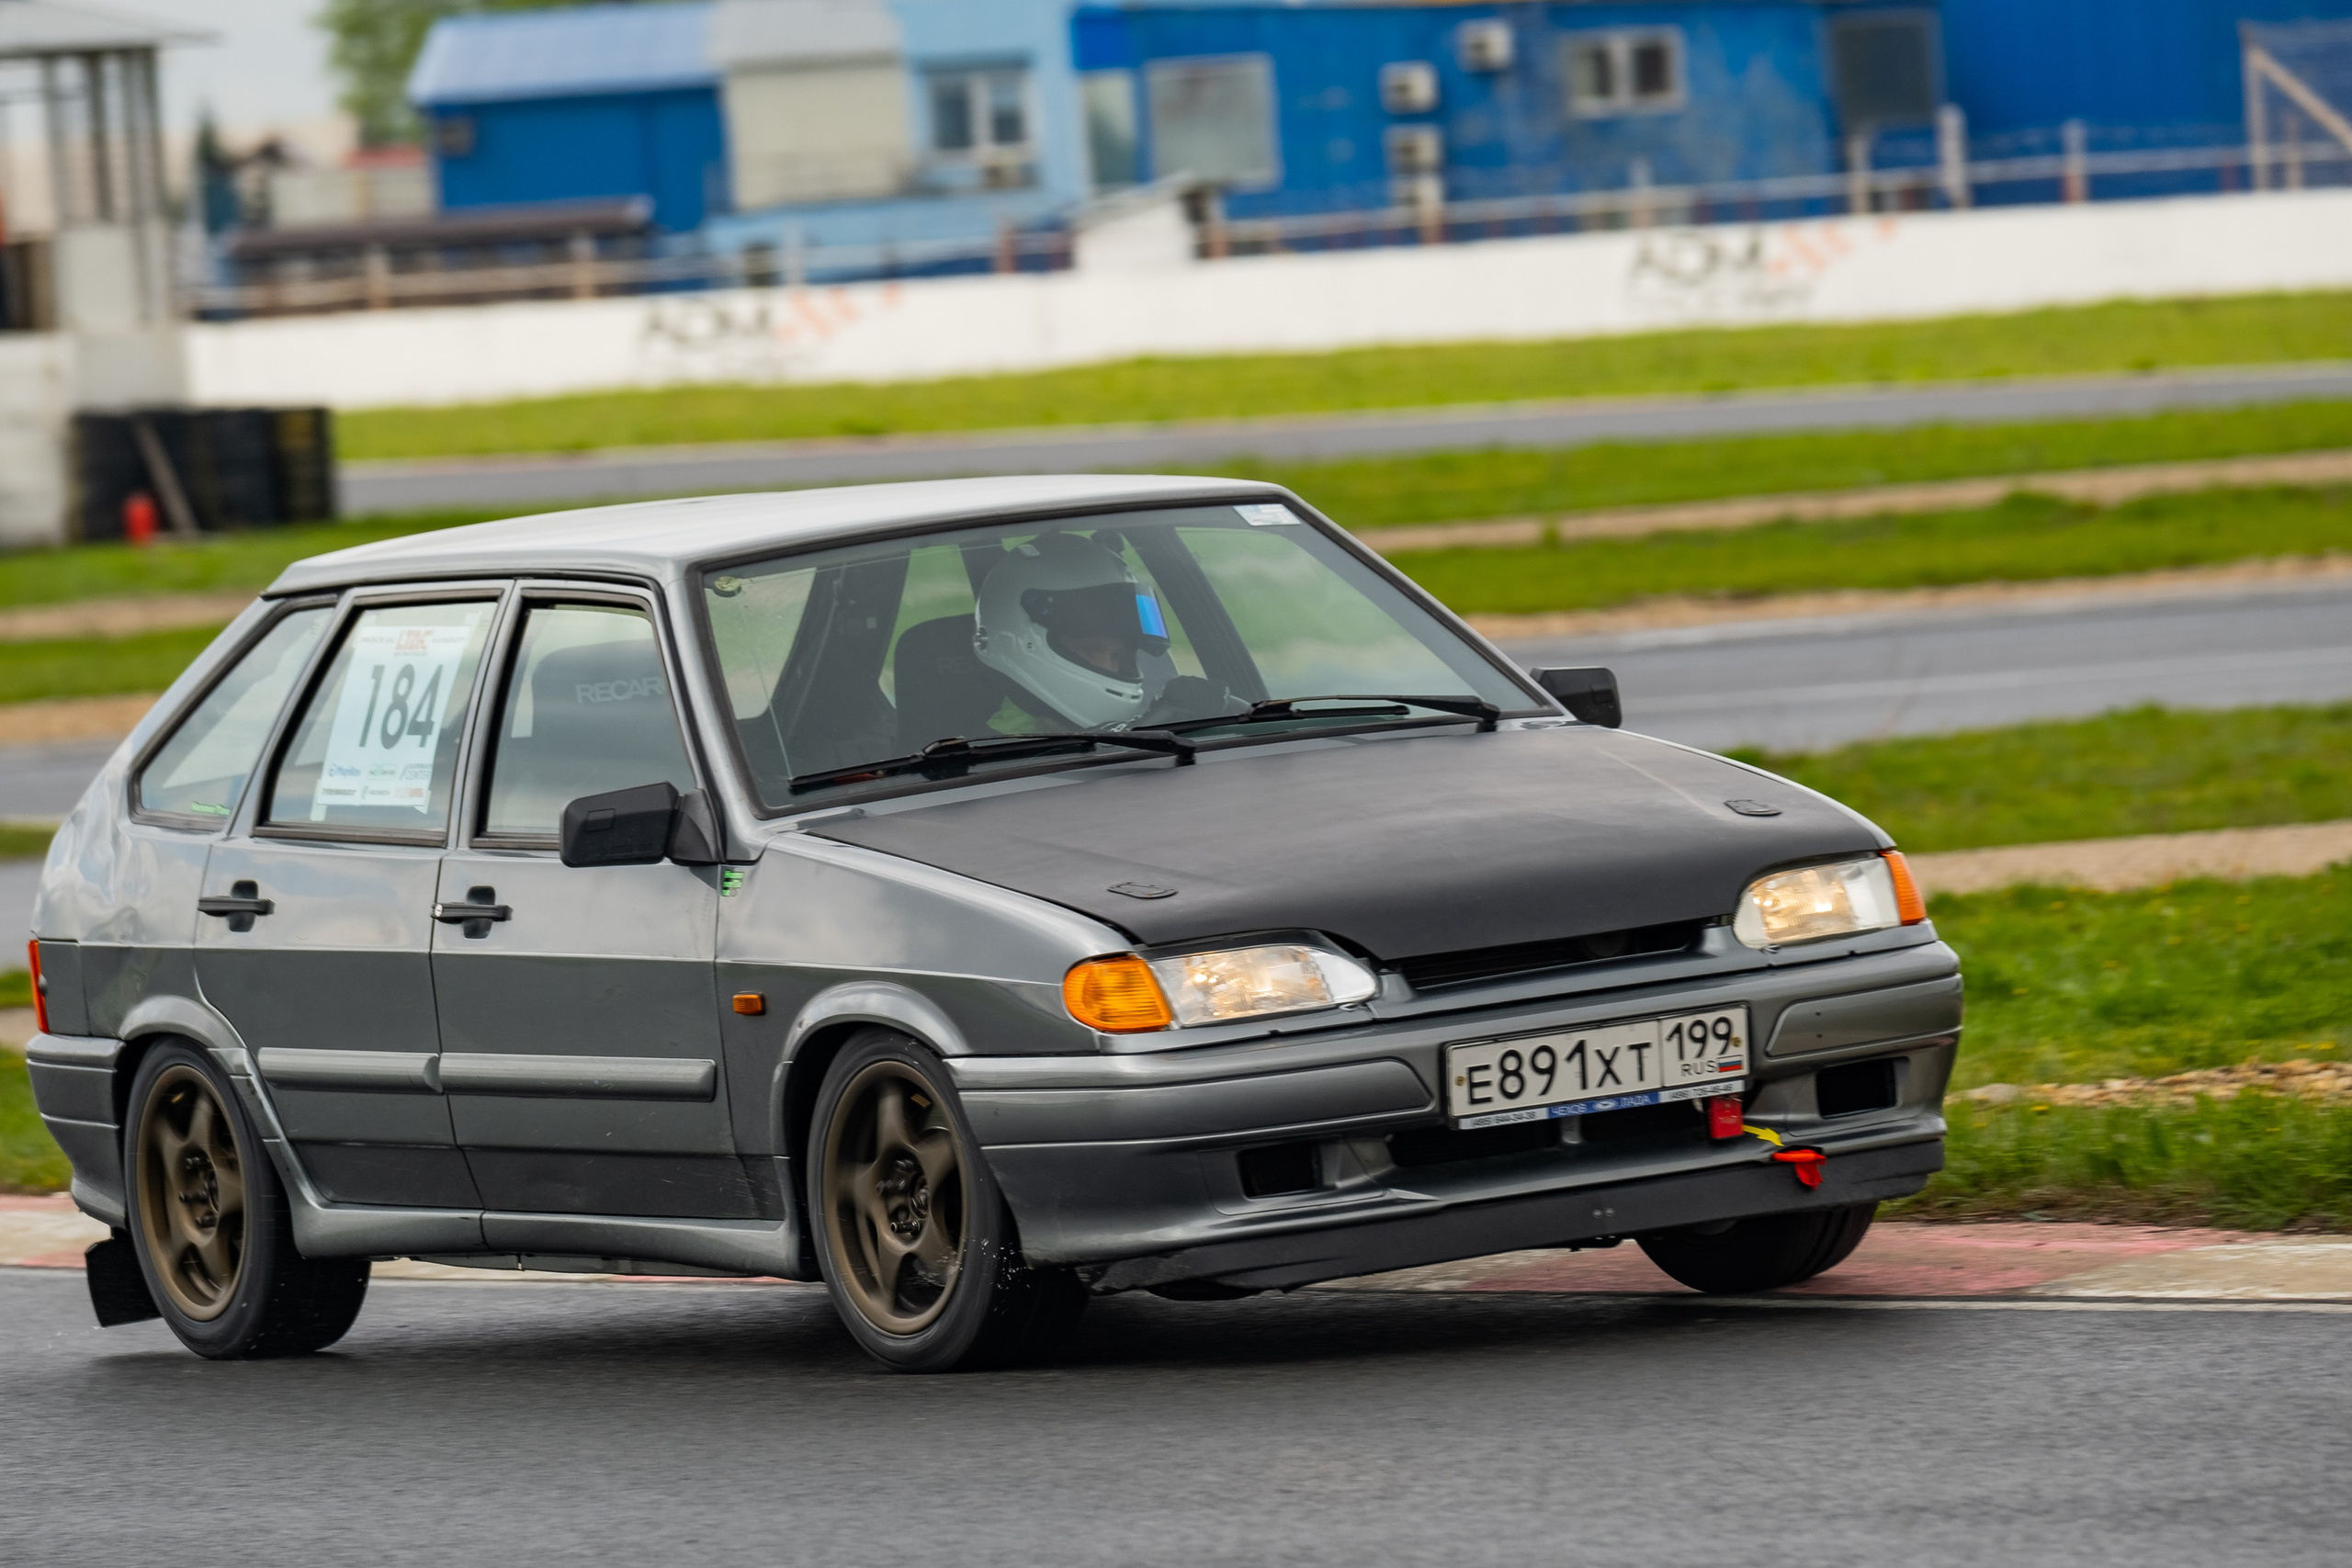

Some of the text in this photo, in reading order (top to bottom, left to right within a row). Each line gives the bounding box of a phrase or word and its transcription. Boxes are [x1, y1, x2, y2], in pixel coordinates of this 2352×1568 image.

[358, 663, 444, 750] 184
[575, 676, 666, 704] RECAR
[1666, 1016, 1734, 1061] 199
[1681, 1060, 1718, 1077] RUS
